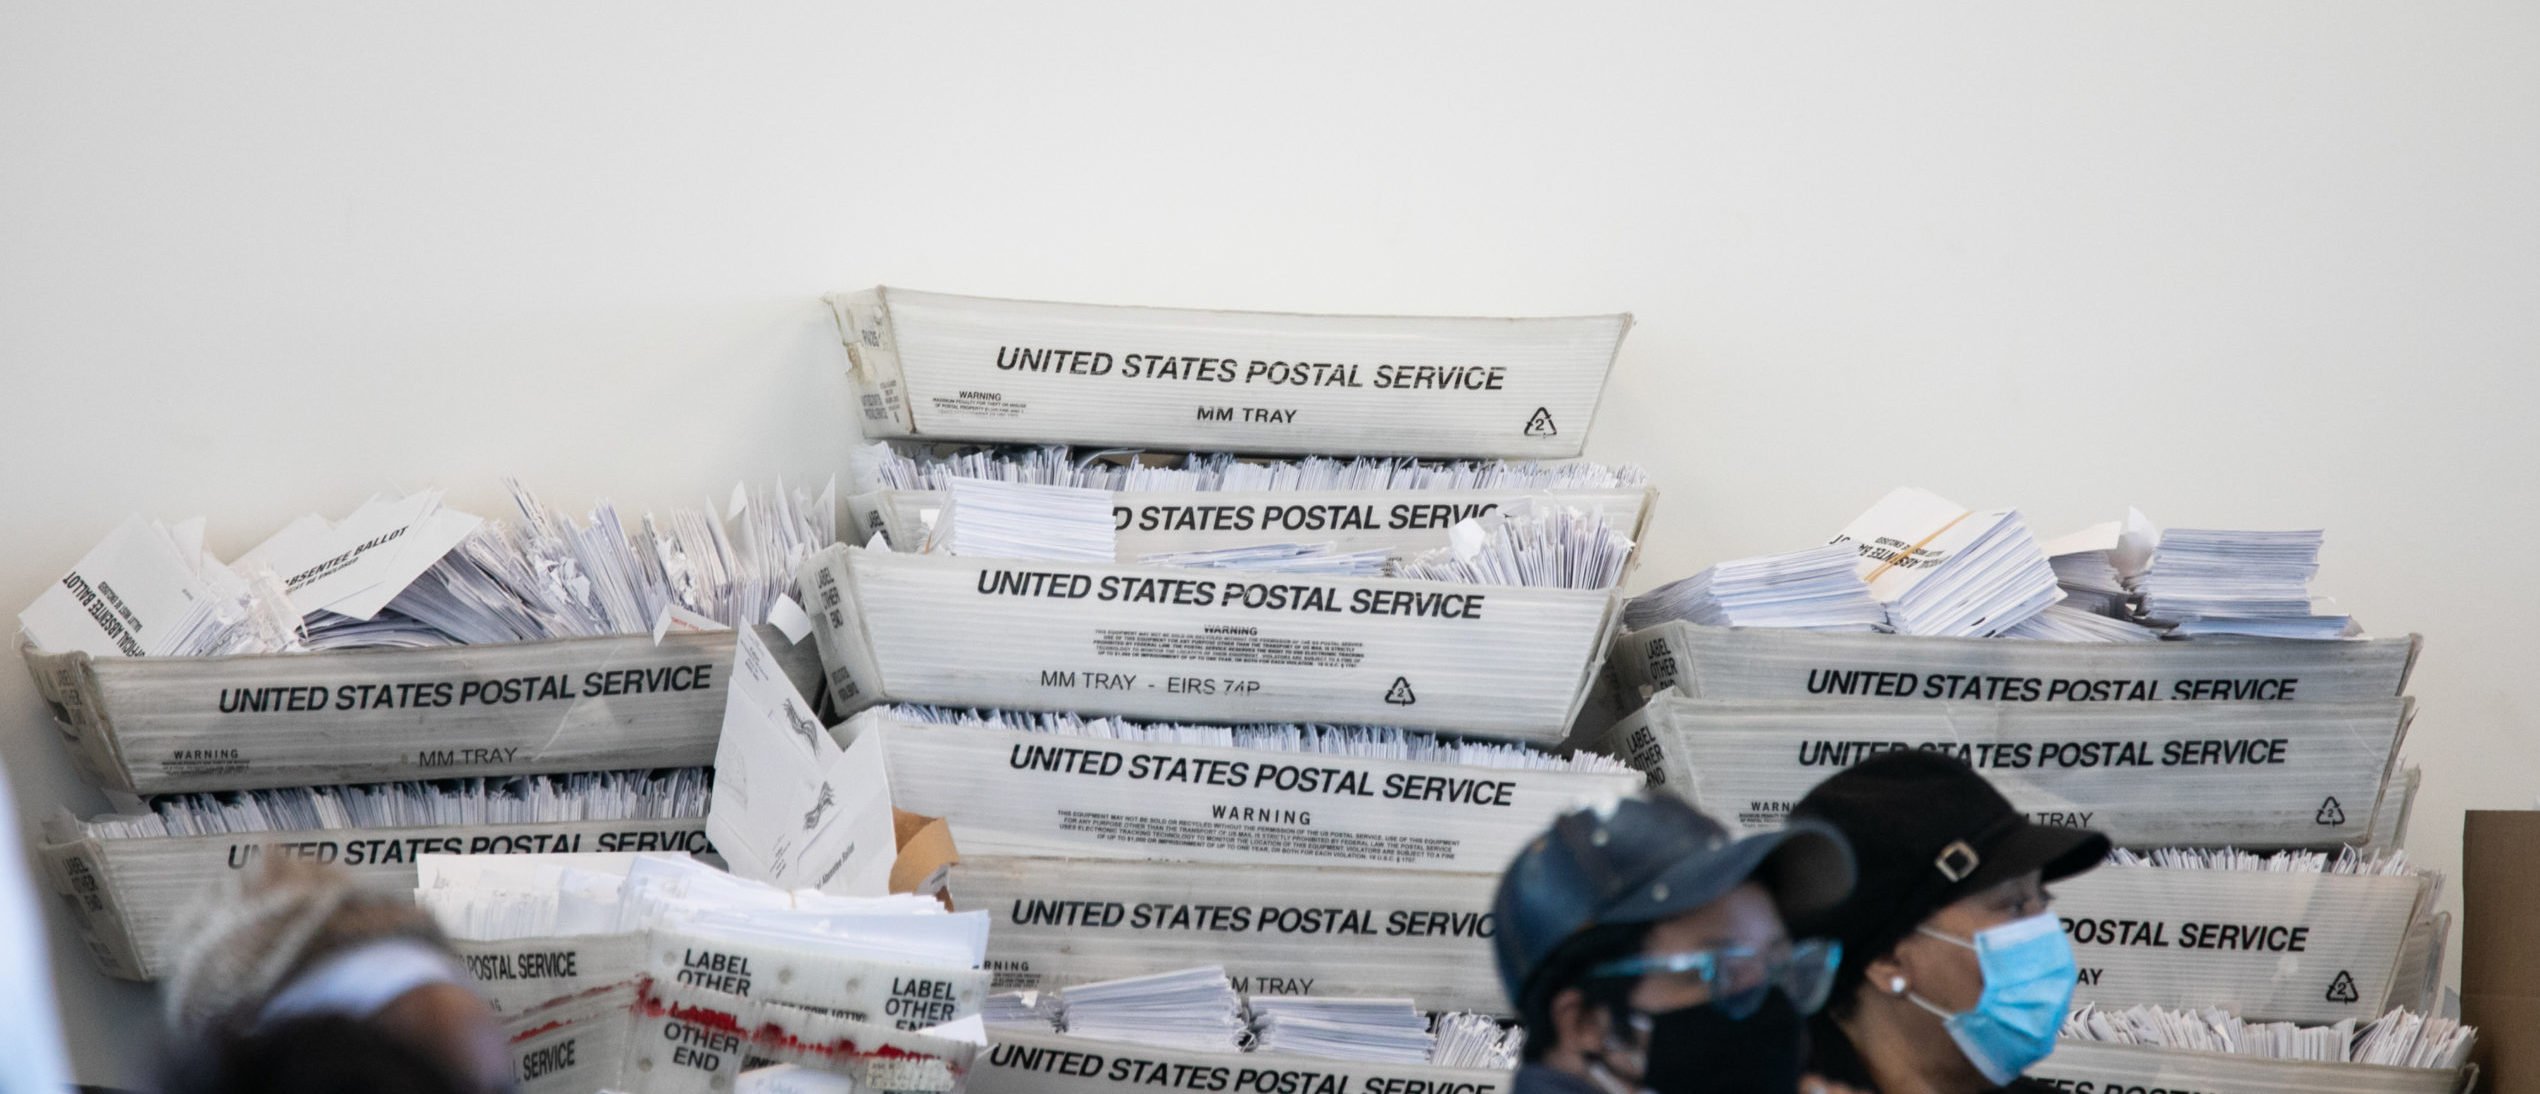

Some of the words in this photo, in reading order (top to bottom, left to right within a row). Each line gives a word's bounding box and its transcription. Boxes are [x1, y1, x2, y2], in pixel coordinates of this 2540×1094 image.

[996, 346, 1113, 376] UNITED
[1121, 353, 1238, 383] STATES
[1245, 360, 1363, 388] POSTAL
[1373, 364, 1507, 391] SERVICE
[959, 391, 1001, 401] WARNING
[1197, 406, 1233, 422] MM
[1242, 407, 1298, 423] TRAY
[1535, 419, 1544, 431] 2
[1138, 505, 1256, 531] STATES
[1260, 505, 1381, 531] POSTAL
[1388, 503, 1499, 530] SERVI
[353, 525, 410, 556] BALLOT
[62, 571, 97, 607] BALLOT
[977, 569, 1092, 600] UNITED
[1097, 575, 1216, 608] STATES
[1221, 582, 1343, 612] POSTAL
[1350, 588, 1485, 619] SERVICE
[88, 598, 125, 639] ABSENTEE
[1204, 624, 1258, 637] WARNING
[1644, 637, 1671, 659] LABEL
[1650, 657, 1678, 680] OTHER
[219, 685, 329, 714] UNITED
[335, 682, 453, 711] STATES
[460, 674, 576, 705] POSTAL
[583, 664, 713, 697] SERVICE
[1040, 670, 1075, 688] MM
[1082, 672, 1137, 691] TRAY
[1167, 676, 1216, 695] EIRS
[1807, 669, 1918, 697] UNITED
[1923, 673, 2042, 701] STATES
[2047, 679, 2163, 701] POSTAL
[2171, 679, 2298, 701] SERVICE
[1626, 725, 1656, 754] LABEL
[173, 748, 239, 760] WARNING
[419, 750, 454, 768] MM
[462, 747, 518, 765] TRAY
[1633, 743, 1664, 770] OTHER
[2038, 741, 2153, 768] POSTAL
[2161, 739, 2288, 766] SERVICE
[1009, 744, 1123, 777] UNITED
[1128, 754, 1249, 788] STATES
[1254, 763, 1375, 796] POSTAL
[1382, 773, 1516, 807] SERVICE
[1212, 804, 1311, 826] WARNING
[2037, 812, 2094, 829] TRAY
[228, 841, 338, 870] UTED
[344, 837, 463, 865] STATES
[470, 834, 580, 855] POSTAL
[1011, 899, 1124, 928] UNITED
[1130, 903, 1250, 931] STATES
[1257, 906, 1378, 935] POSTAL
[1386, 910, 1497, 938] SERVIC
[2059, 918, 2169, 947] POSTAL
[2178, 922, 2309, 953] SERVICE
[518, 952, 577, 978] SERVICE
[684, 948, 751, 977] LABEL
[983, 960, 1029, 971] RNING
[677, 969, 751, 997] OTHER
[892, 977, 956, 1001] LABEL
[1256, 977, 1314, 996] TRAY
[2077, 968, 2103, 986] AY
[885, 998, 955, 1021] OTHER
[664, 1022, 740, 1055] OTHER
[523, 1040, 575, 1081] SERVICE
[673, 1046, 720, 1072] END
[989, 1044, 1103, 1078] UNITED
[1108, 1057, 1230, 1092] STATES
[1234, 1068, 1350, 1094] POSTAL
